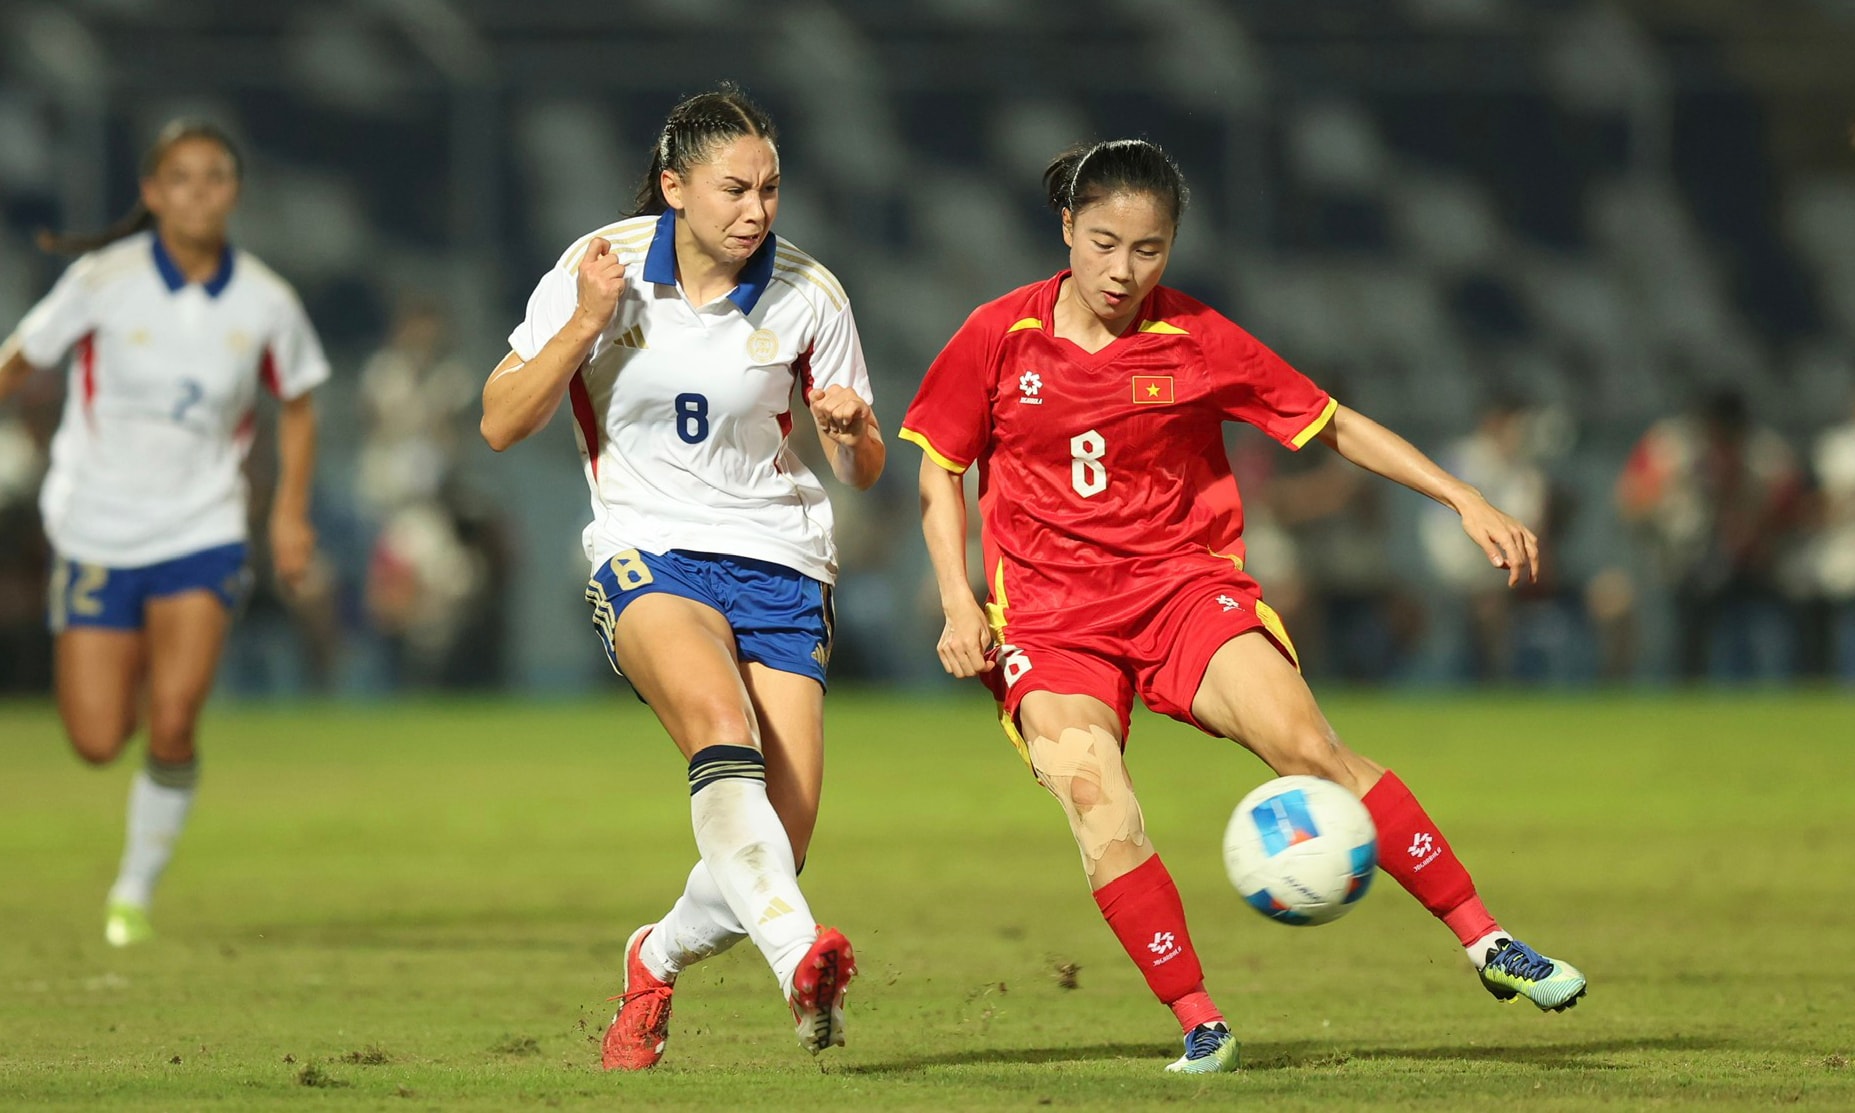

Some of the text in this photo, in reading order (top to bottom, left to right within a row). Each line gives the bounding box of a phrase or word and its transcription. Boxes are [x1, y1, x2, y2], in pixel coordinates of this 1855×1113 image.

[171, 376, 204, 422] 2
[675, 392, 709, 445] 8
[1070, 429, 1107, 498] 8
[73, 560, 109, 616] 2
[610, 548, 654, 592] 8
